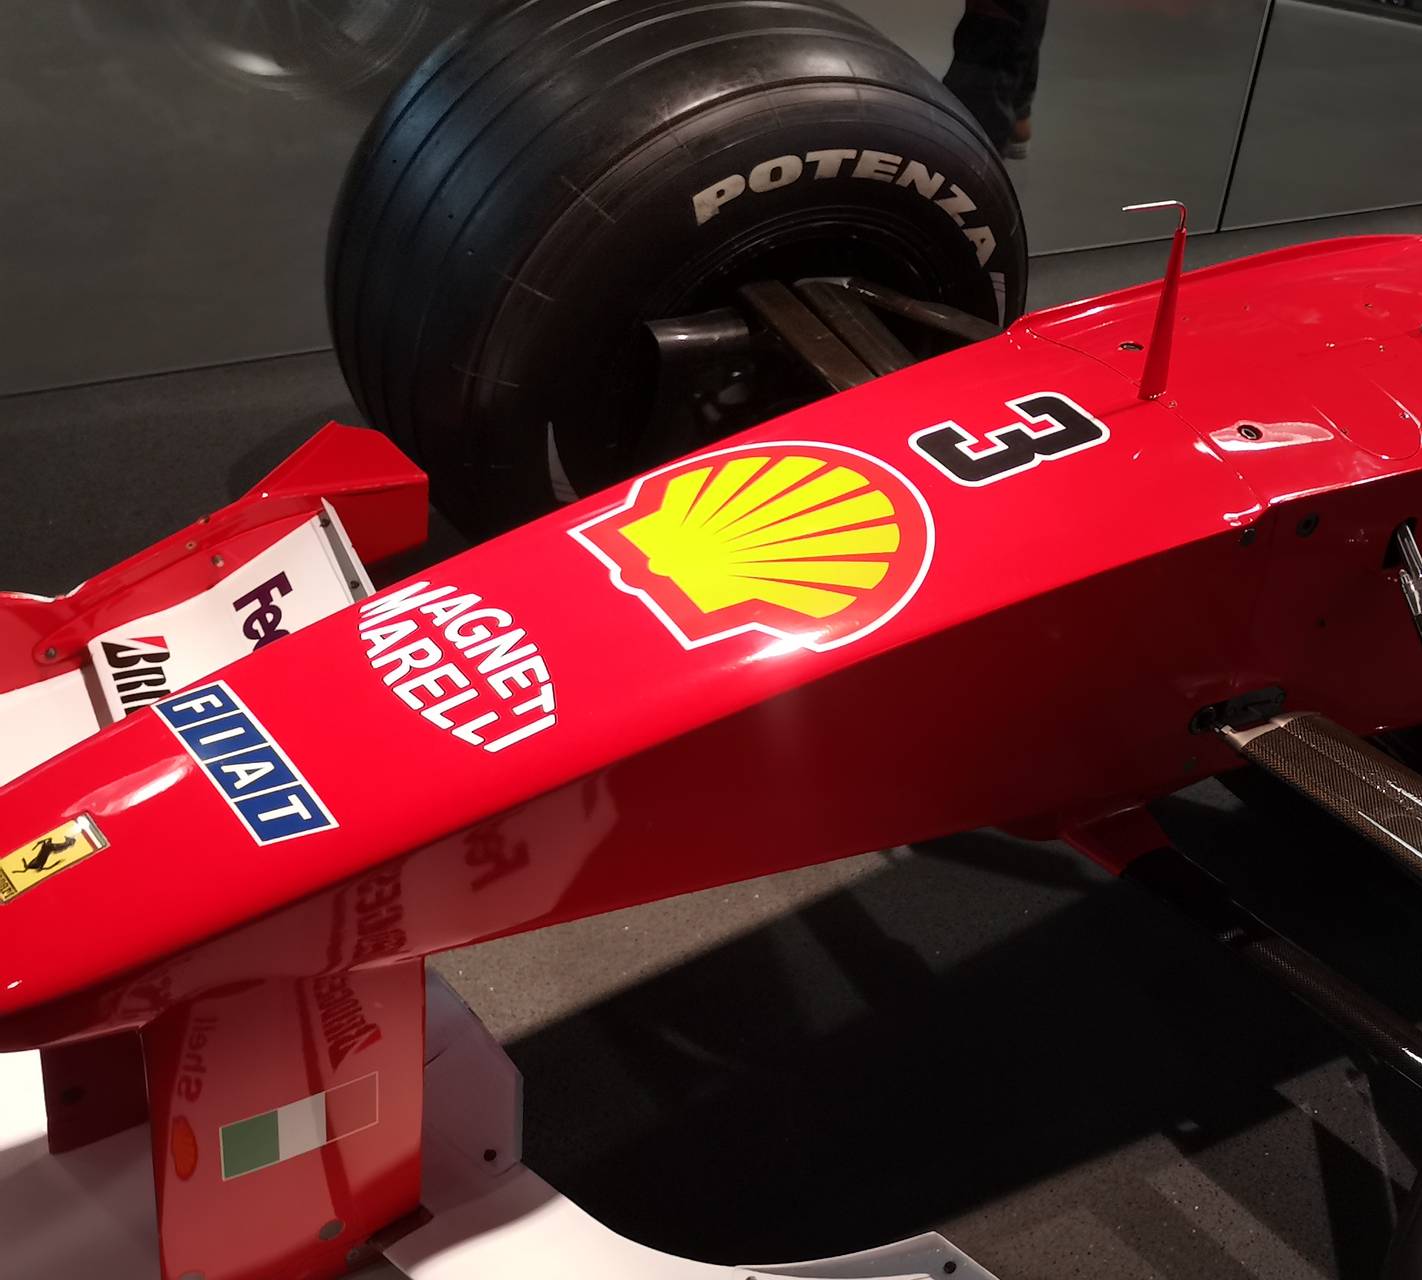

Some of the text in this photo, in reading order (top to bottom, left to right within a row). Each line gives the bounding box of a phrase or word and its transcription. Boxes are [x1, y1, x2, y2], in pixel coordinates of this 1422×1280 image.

[692, 149, 997, 267] POTENZA
[908, 391, 1110, 487] 3
[358, 580, 557, 753] MAGNETI
[358, 582, 557, 753] MARELLI
[171, 693, 313, 822] FIAT
